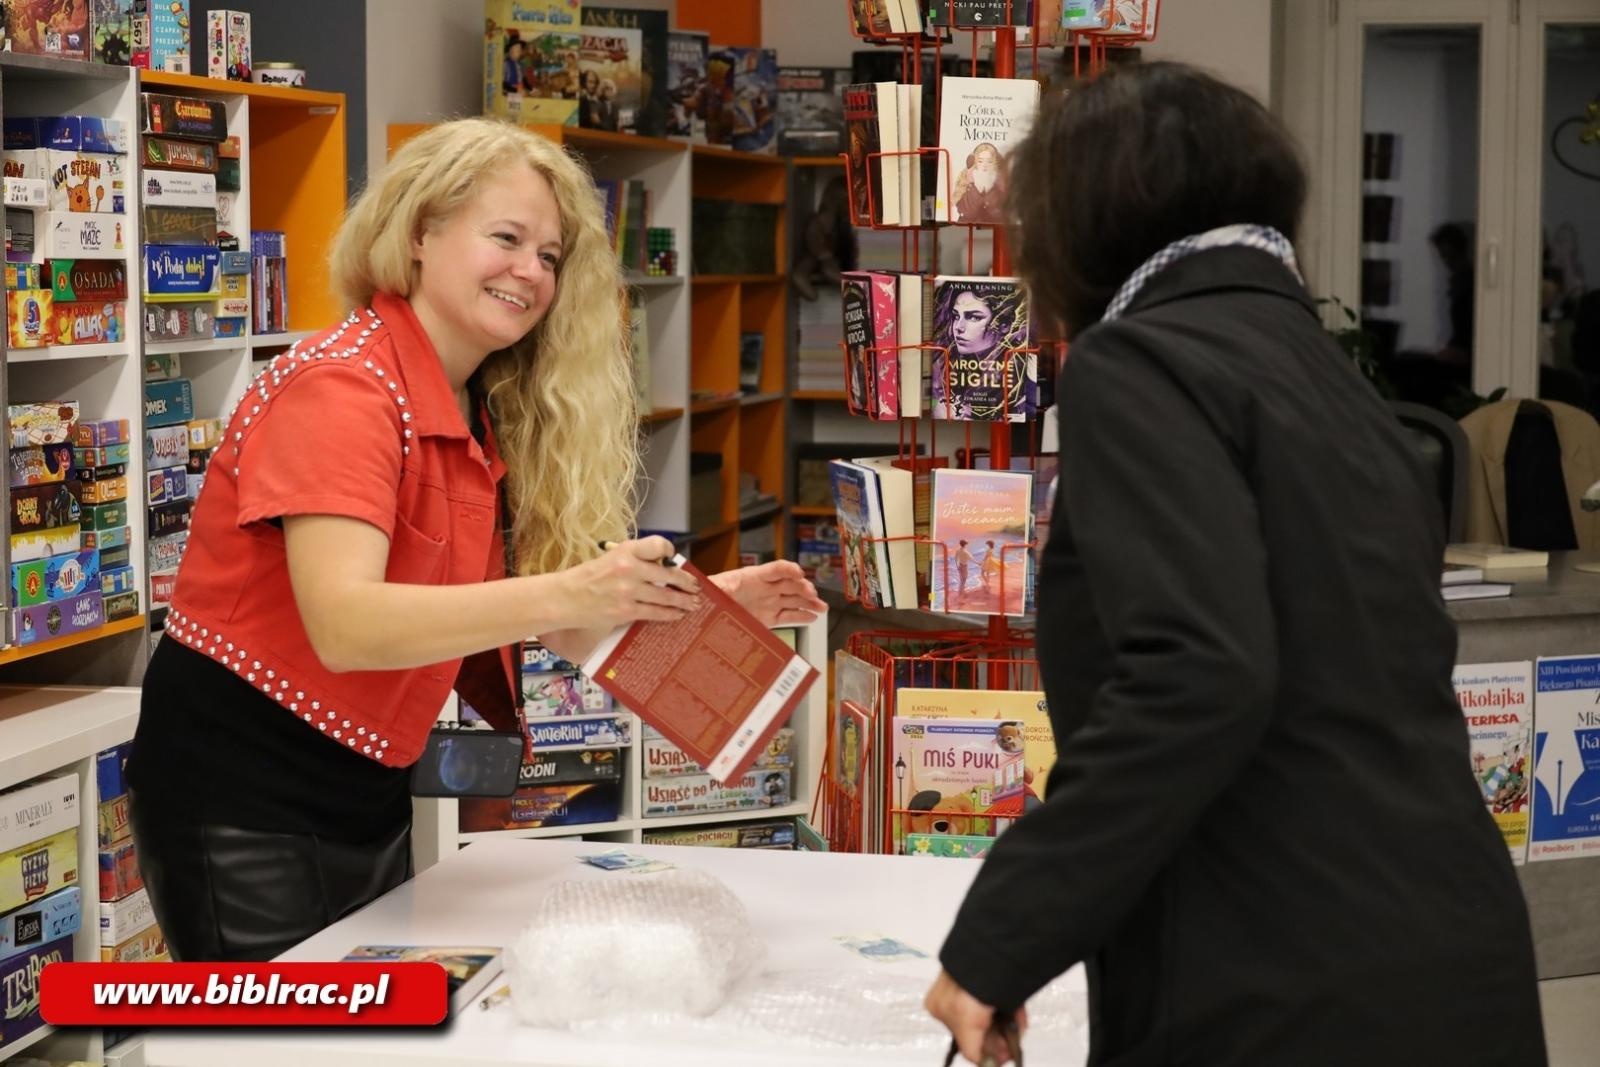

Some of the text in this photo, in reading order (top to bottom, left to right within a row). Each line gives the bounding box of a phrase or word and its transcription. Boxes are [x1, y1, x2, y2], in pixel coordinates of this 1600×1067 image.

[133, 21, 142, 45] 567
[968, 104, 1004, 116] CÓRKA
[960, 114, 1012, 128] RODZINY
[964, 128, 1008, 141] MONET
[74, 270, 115, 289] OSADA
[949, 359, 1014, 371] MROCZNE
[950, 372, 1013, 388] SIGILE
[75, 599, 91, 613] GANG
[911, 705, 948, 713] KATARZYNA
[923, 748, 999, 769] MIŚ PUKI
[709, 776, 755, 791] POGU
